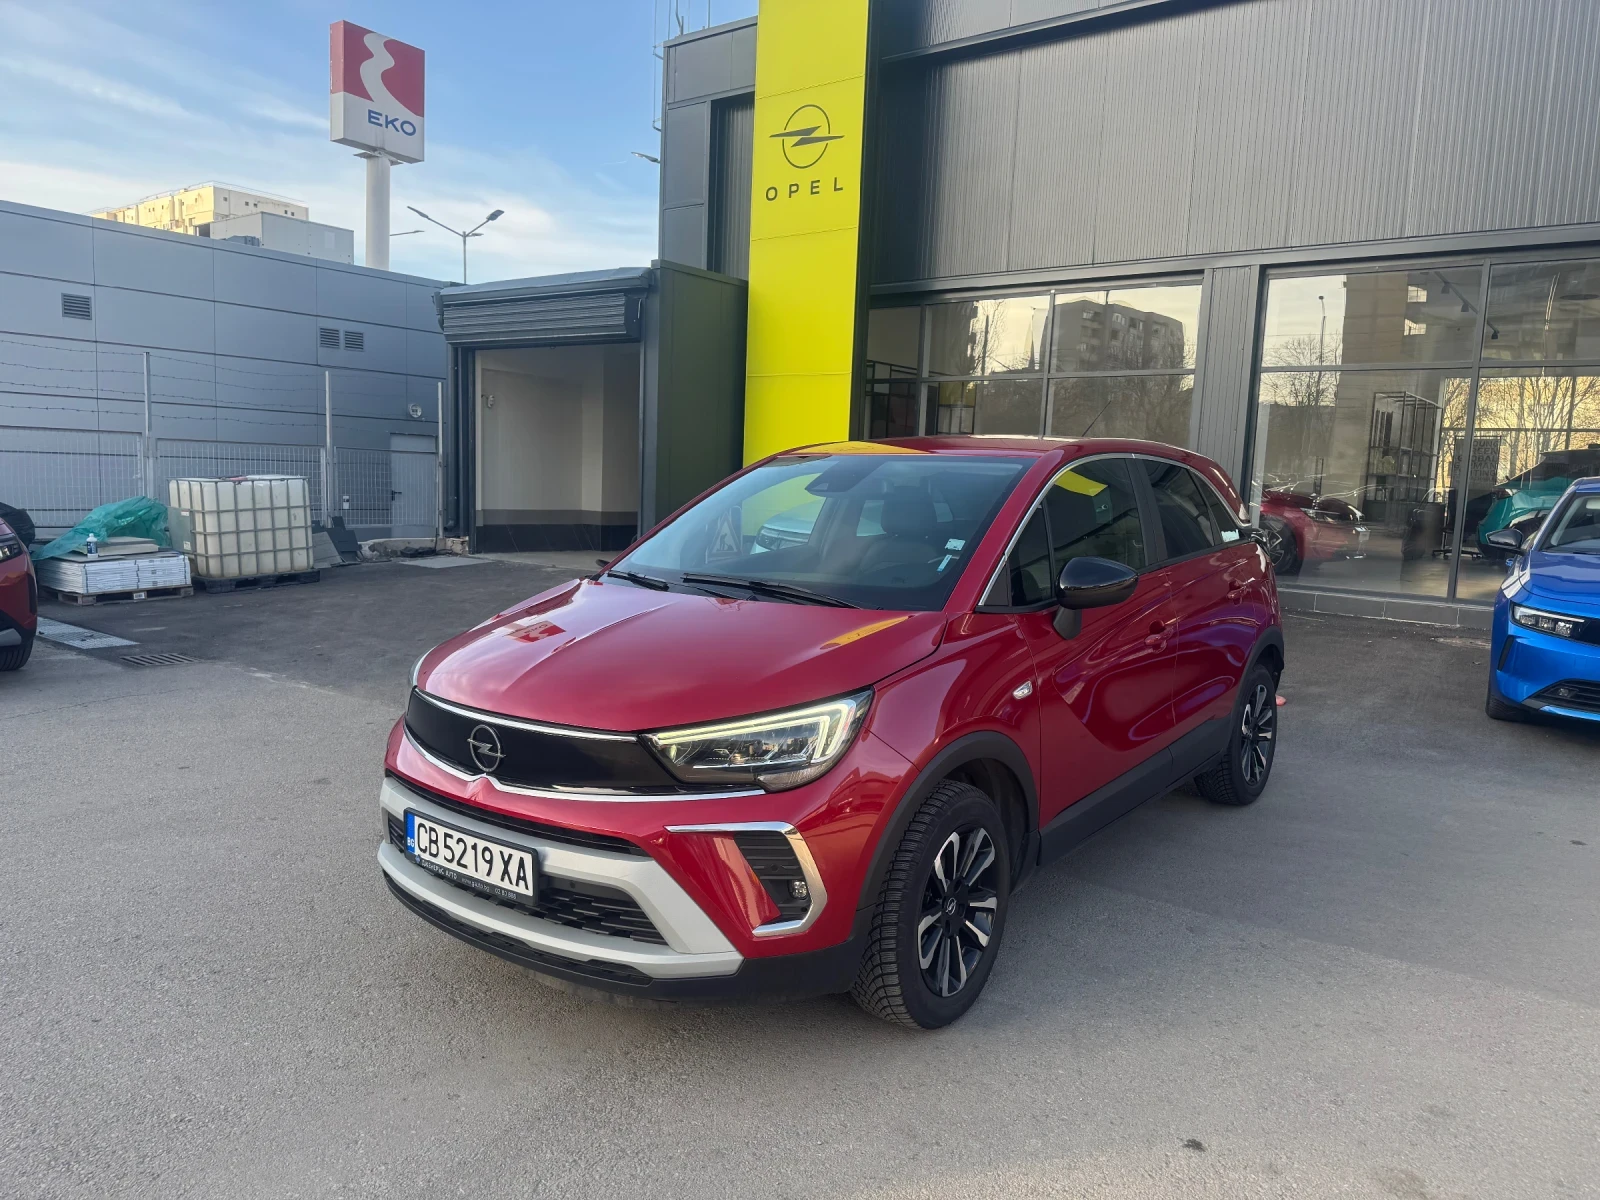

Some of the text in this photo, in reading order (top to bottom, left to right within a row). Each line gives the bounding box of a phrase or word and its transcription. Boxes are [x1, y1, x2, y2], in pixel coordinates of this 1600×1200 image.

[368, 109, 416, 136] EKO
[765, 177, 843, 201] OPEL
[1457, 454, 1497, 462] GOBAL
[407, 836, 415, 848] BG
[417, 822, 530, 891] CB 5219 XA
